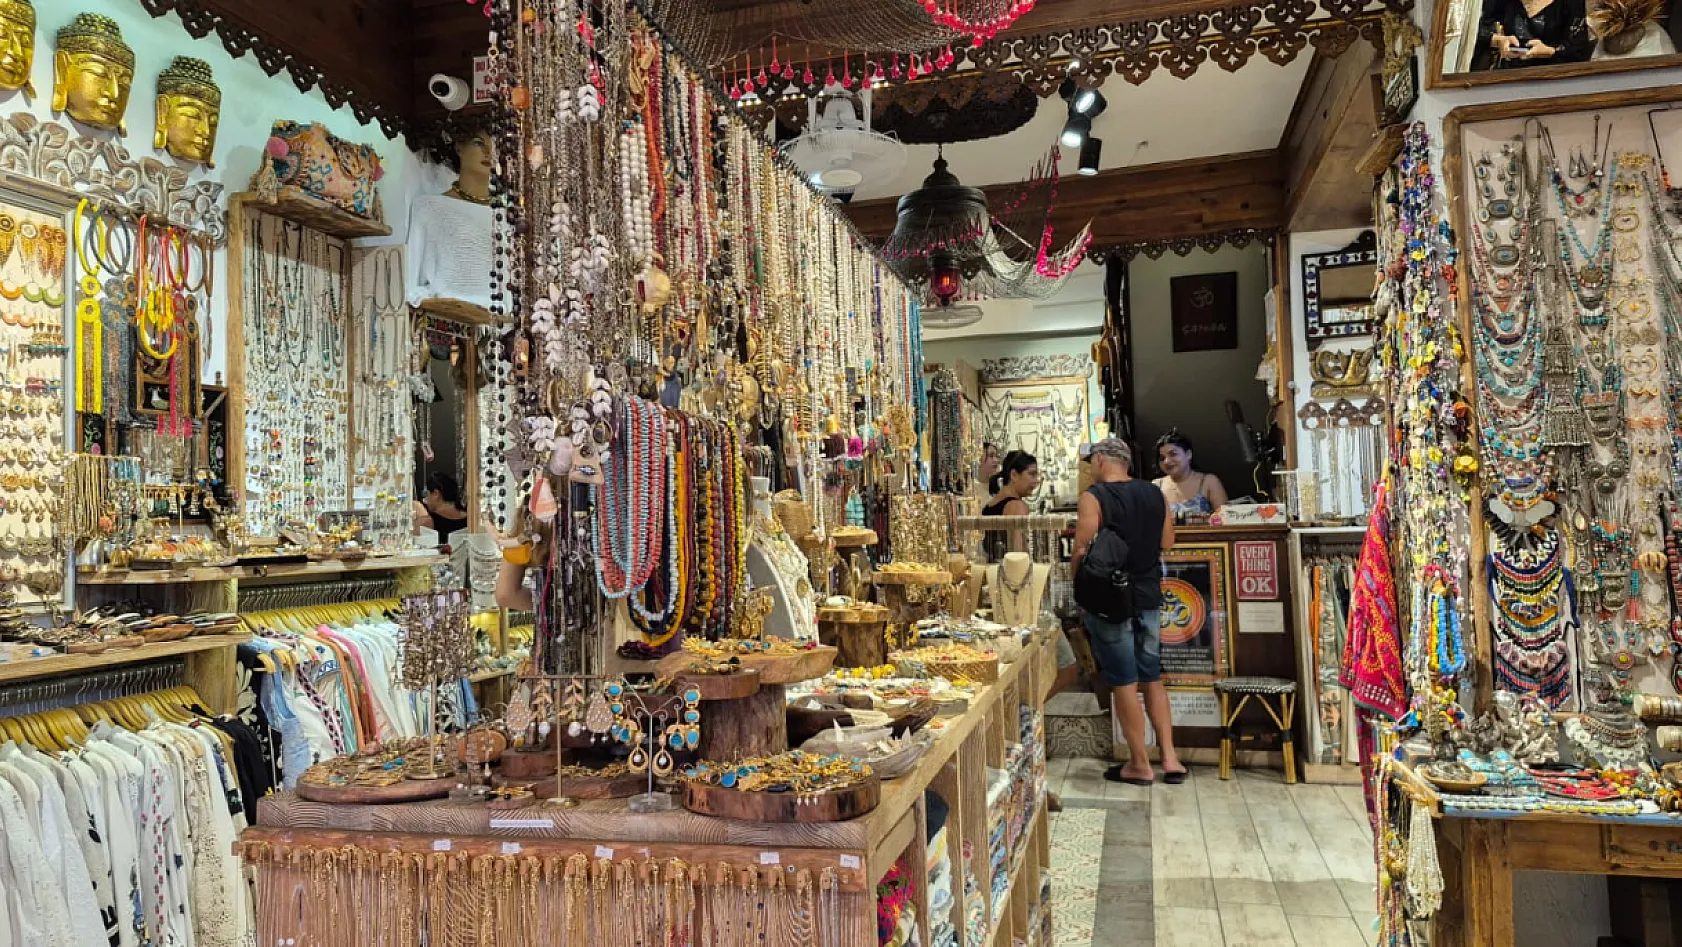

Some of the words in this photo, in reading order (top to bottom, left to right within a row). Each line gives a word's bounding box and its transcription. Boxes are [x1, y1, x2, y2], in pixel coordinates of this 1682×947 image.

[1240, 546, 1270, 559] EVERY
[1241, 559, 1271, 572] THING
[1242, 576, 1274, 593] OK
